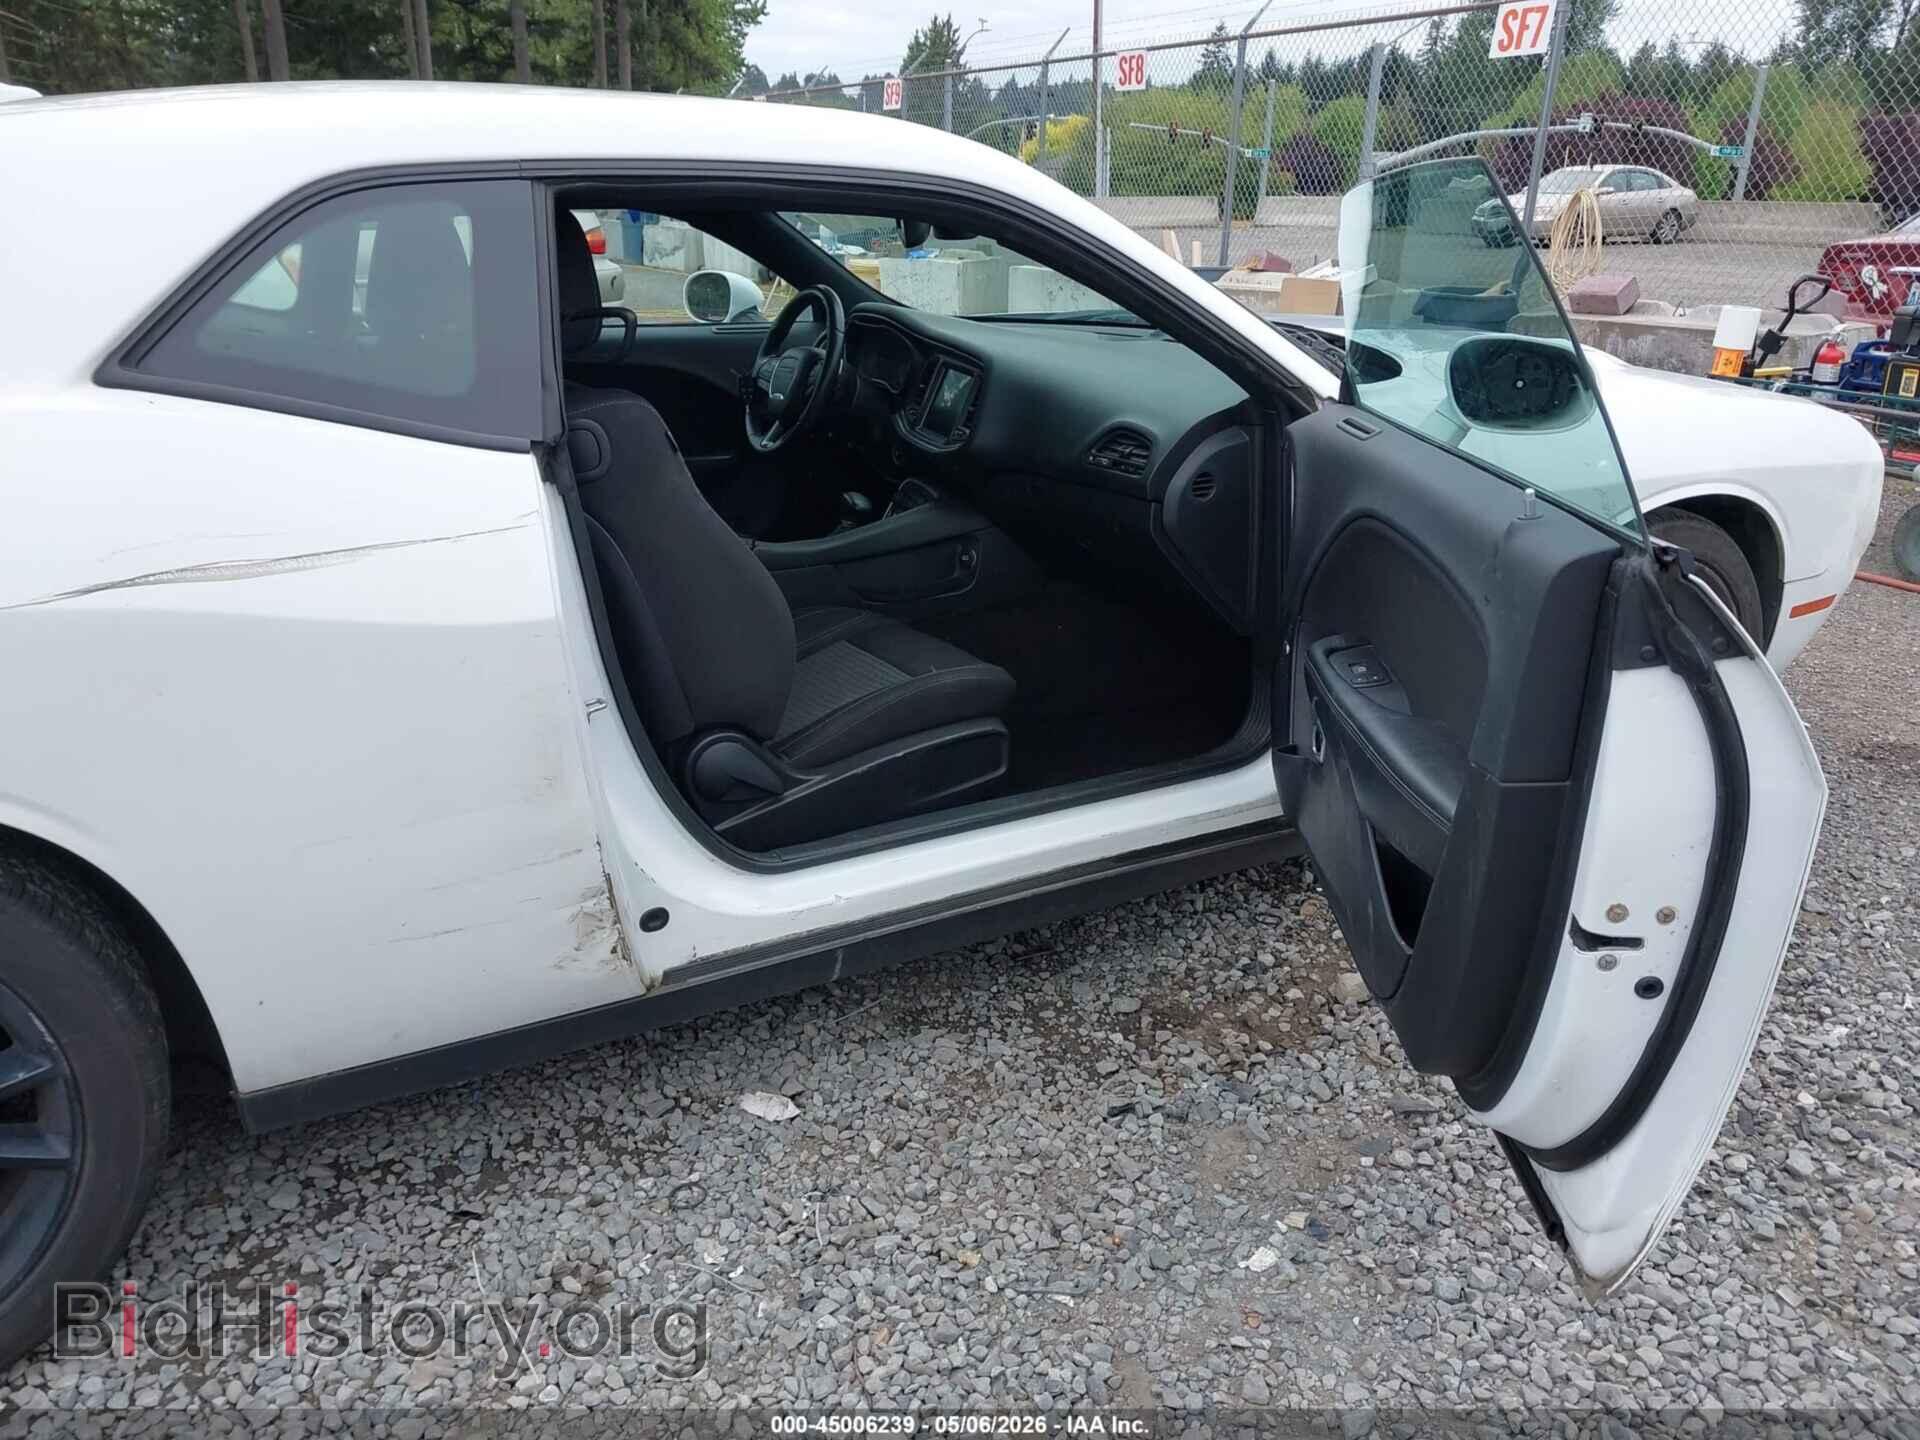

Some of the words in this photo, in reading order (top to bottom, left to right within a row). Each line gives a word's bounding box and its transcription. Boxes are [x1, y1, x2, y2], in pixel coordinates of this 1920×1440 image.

[1498, 5, 1549, 52] SF7
[1119, 54, 1144, 86] SF8
[885, 82, 901, 106] SF9
